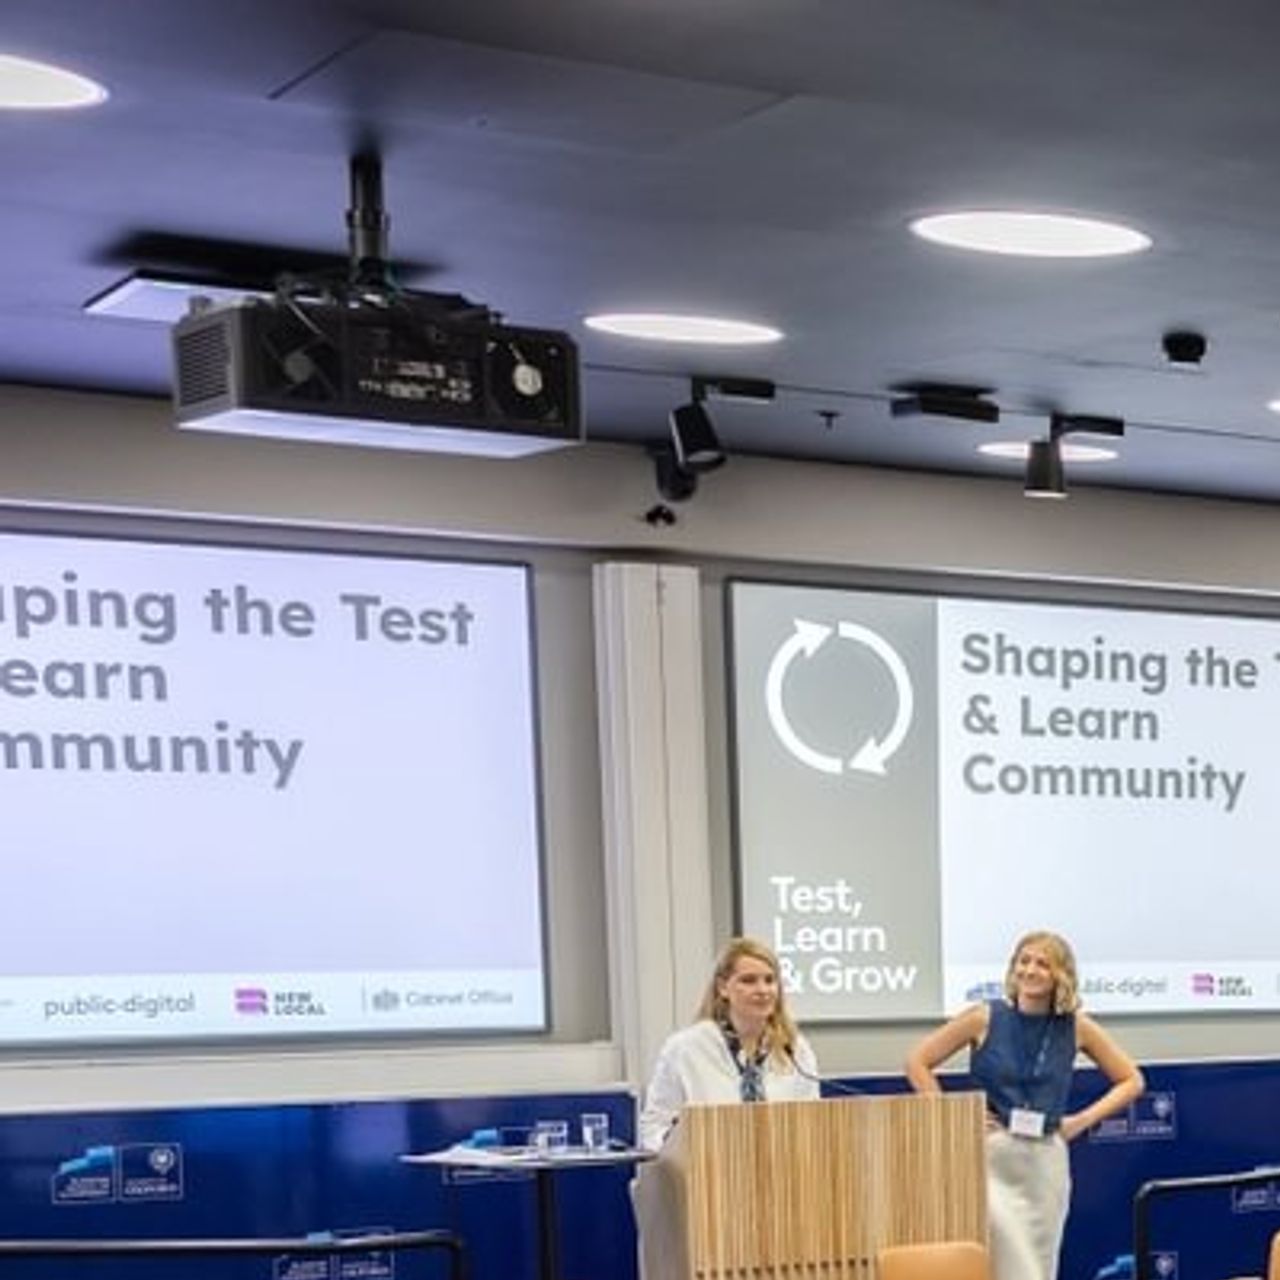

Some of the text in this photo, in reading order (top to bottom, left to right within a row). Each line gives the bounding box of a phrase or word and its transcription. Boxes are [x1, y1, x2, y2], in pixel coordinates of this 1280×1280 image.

[0, 571, 474, 645] ping the Test
[0, 660, 167, 701] earn
[962, 633, 1167, 698] Shaping
[1186, 646, 1258, 688] the
[963, 694, 1159, 741] & Learn
[963, 754, 1245, 812] Community
[770, 876, 863, 919] Test,
[774, 916, 886, 952] Learn
[779, 956, 917, 994] & Grow
